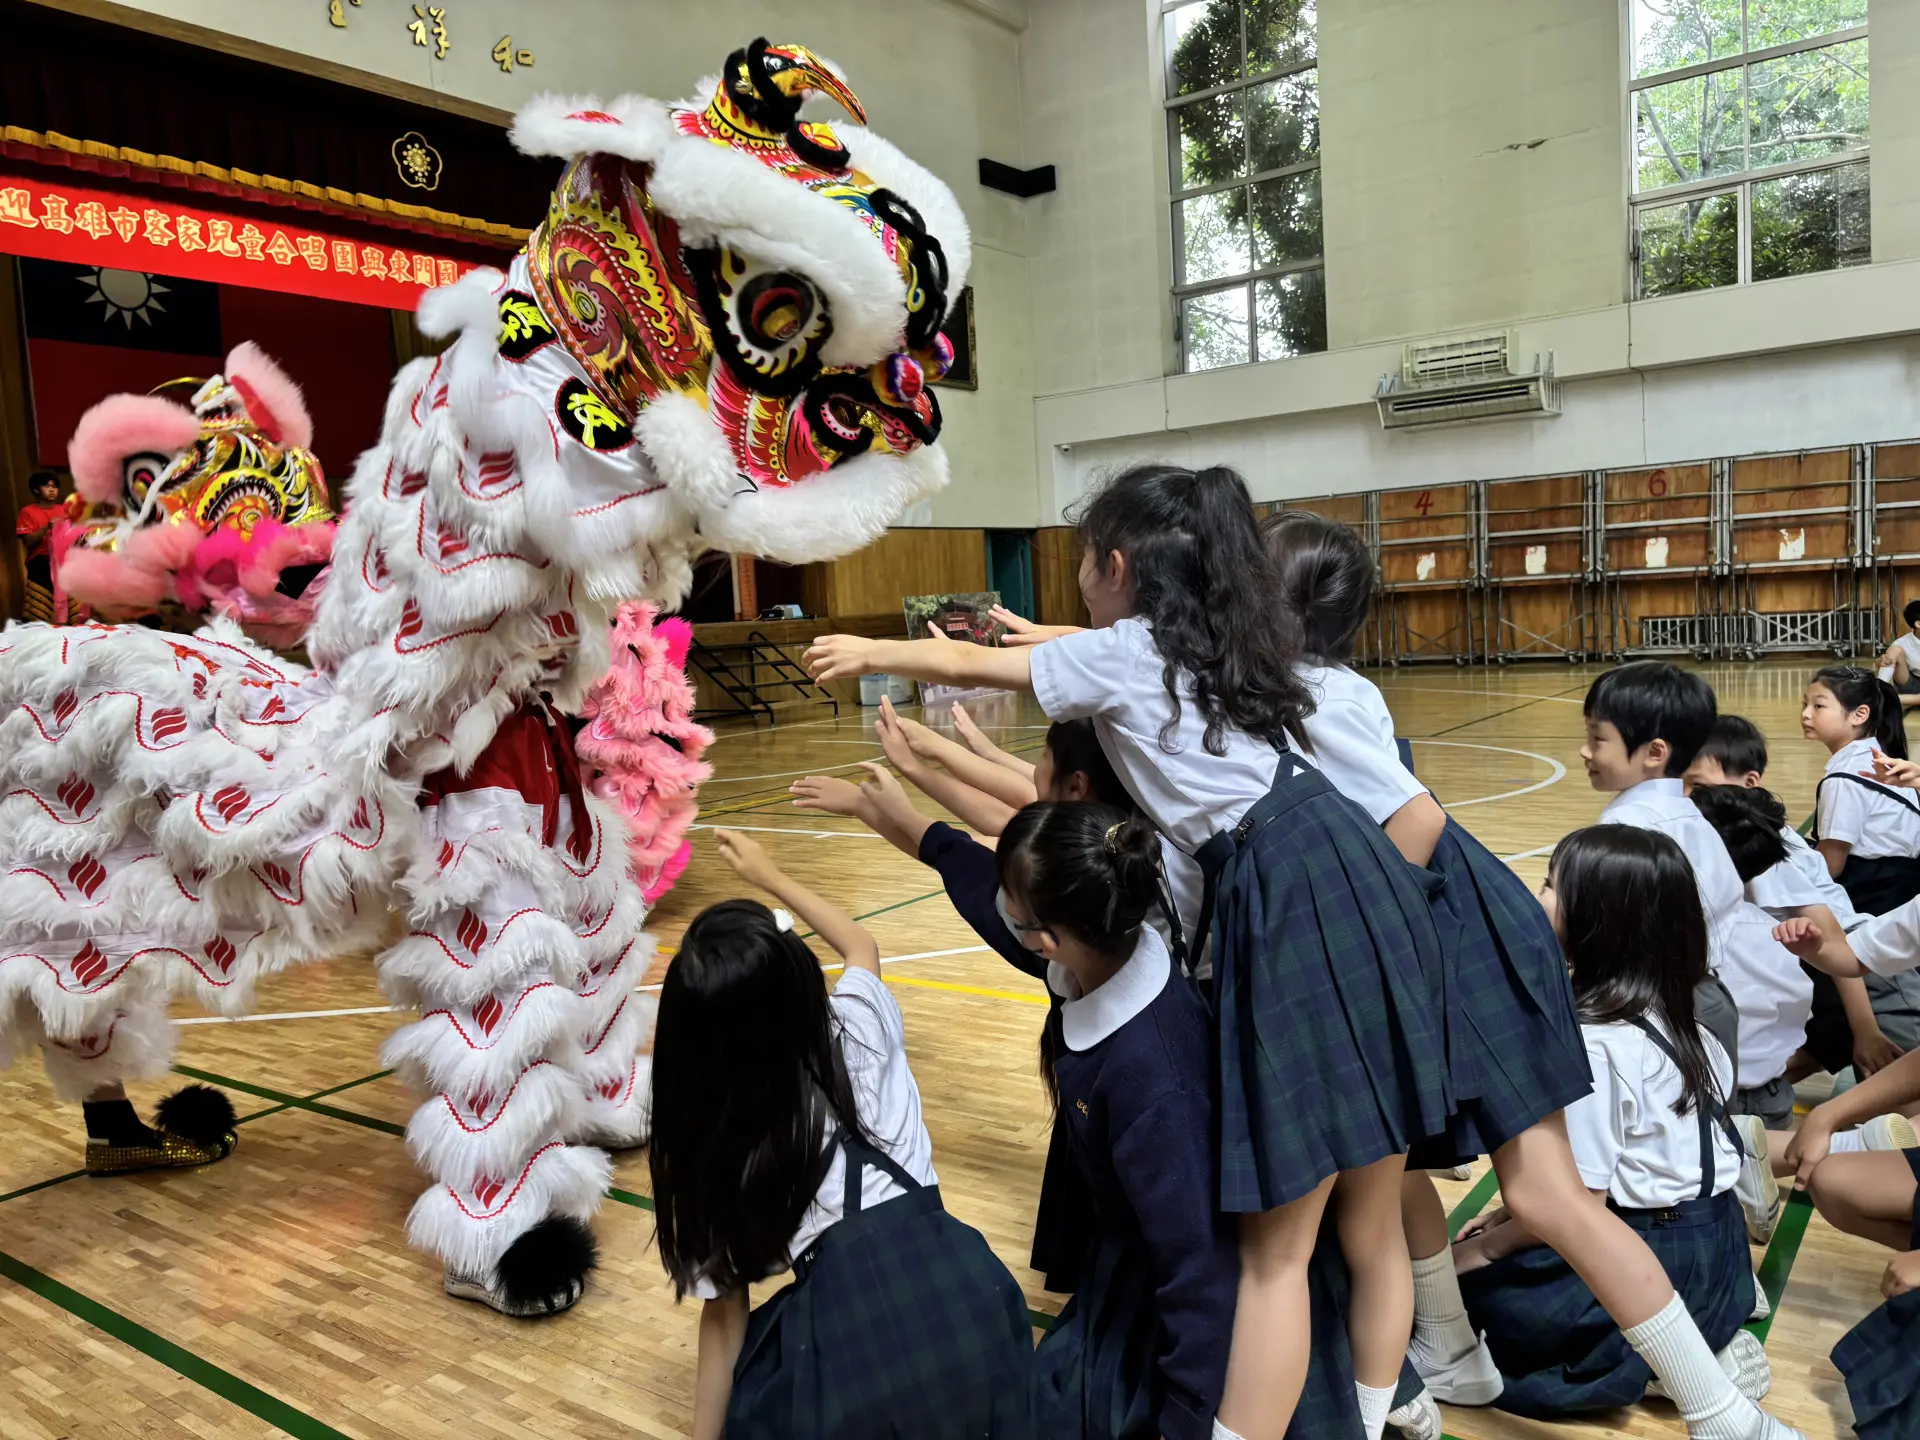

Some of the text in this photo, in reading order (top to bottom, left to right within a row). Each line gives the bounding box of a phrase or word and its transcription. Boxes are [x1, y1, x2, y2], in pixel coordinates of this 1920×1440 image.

[0, 187, 474, 288] 迎高雄市客家兒童合唱團與東門國
[1648, 469, 1667, 497] 6
[1414, 490, 1434, 516] 4
